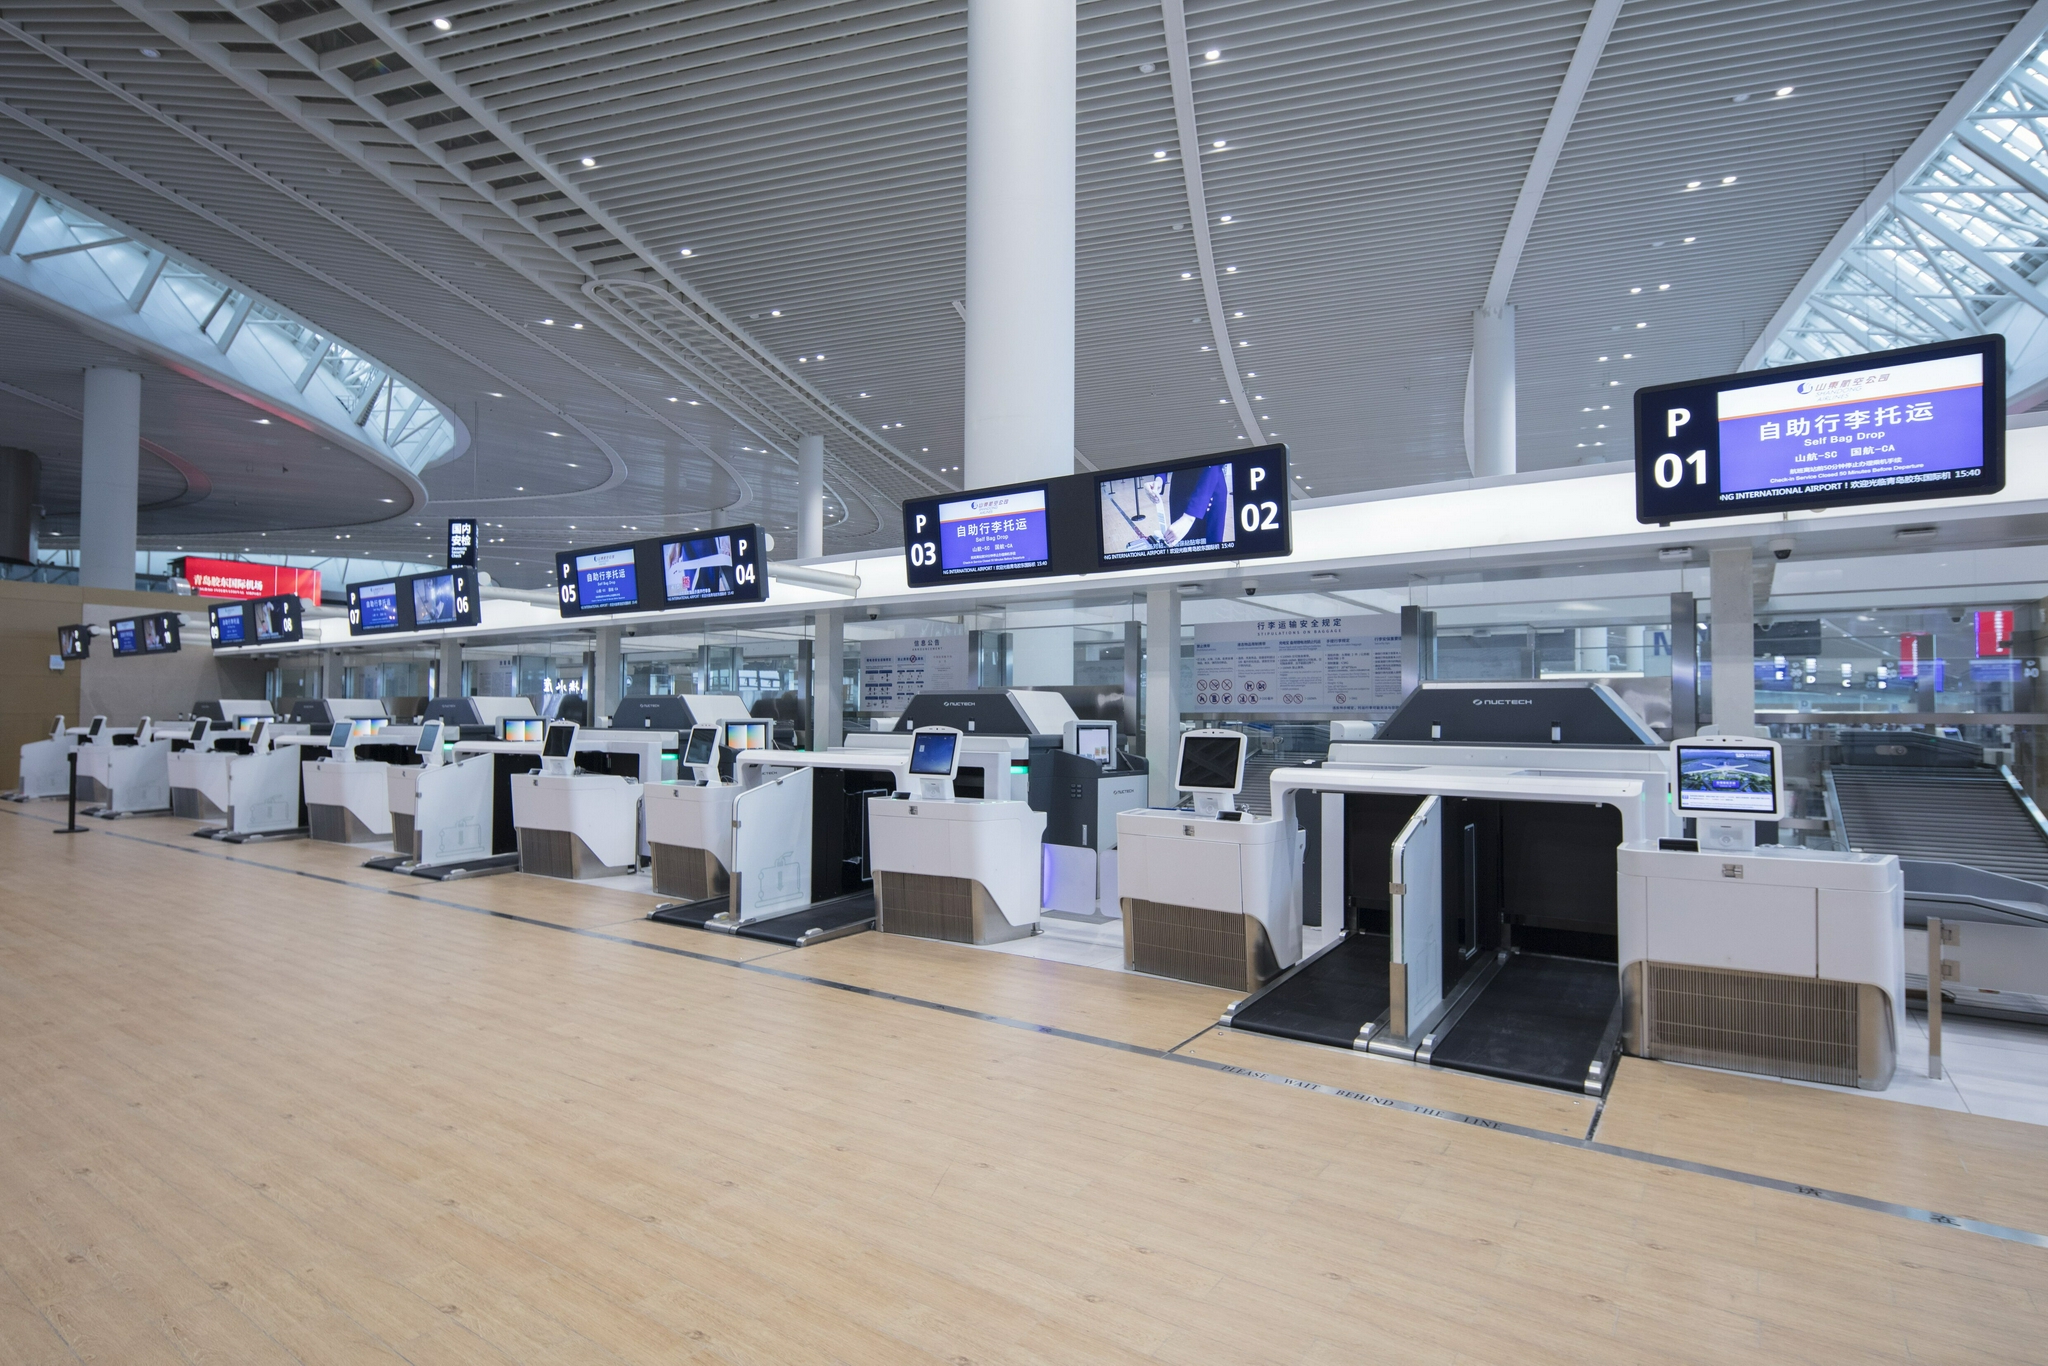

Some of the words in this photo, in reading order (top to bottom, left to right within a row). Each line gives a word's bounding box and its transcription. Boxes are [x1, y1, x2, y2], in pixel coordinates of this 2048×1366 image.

[1816, 386, 1862, 397] SHANDONG
[1817, 393, 1850, 401] AIRLINES
[1668, 408, 1691, 437] P
[1760, 401, 1934, 441] 自助行李托运
[1804, 437, 1827, 447] Self
[1830, 435, 1853, 444] Bag
[1857, 431, 1886, 440] Drop
[1654, 450, 1706, 488] 01
[1893, 463, 1924, 471] Departure
[1251, 467, 1266, 491] P
[1735, 487, 1803, 500] INTERNATIONAL
[1955, 469, 1981, 478] 15:40
[916, 514, 927, 534] P
[1240, 501, 1279, 532] 02
[452, 523, 471, 534] 国内
[957, 518, 1028, 538] 自助行李托运
[451, 534, 471, 546] 安检
[739, 539, 748, 556] P
[911, 542, 937, 567] 03
[1112, 551, 1146, 559] INTERNATIONAL
[563, 563, 570, 579] P
[735, 563, 755, 585] 04
[194, 575, 263, 591] 青岛胶东国际机场
[457, 578, 464, 591] P
[350, 592, 356, 605] P
[561, 584, 576, 603] 05
[284, 602, 289, 614] P
[456, 596, 469, 613] 06
[211, 612, 216, 623] P
[349, 609, 360, 624] 07
[1257, 618, 1341, 630] 行李运输安全规定
[211, 626, 219, 639] 09
[283, 618, 293, 632] 08
[1775, 671, 1784, 680] E
[1806, 675, 1816, 684] D
[1842, 679, 1851, 688] C
[1220, 1065, 1269, 1080] PLEASE
[1284, 1078, 1321, 1090] WAIT
[1335, 1089, 1394, 1107] BEHIND
[1413, 1105, 1445, 1117] THE
[1463, 1116, 1502, 1129] LINE
